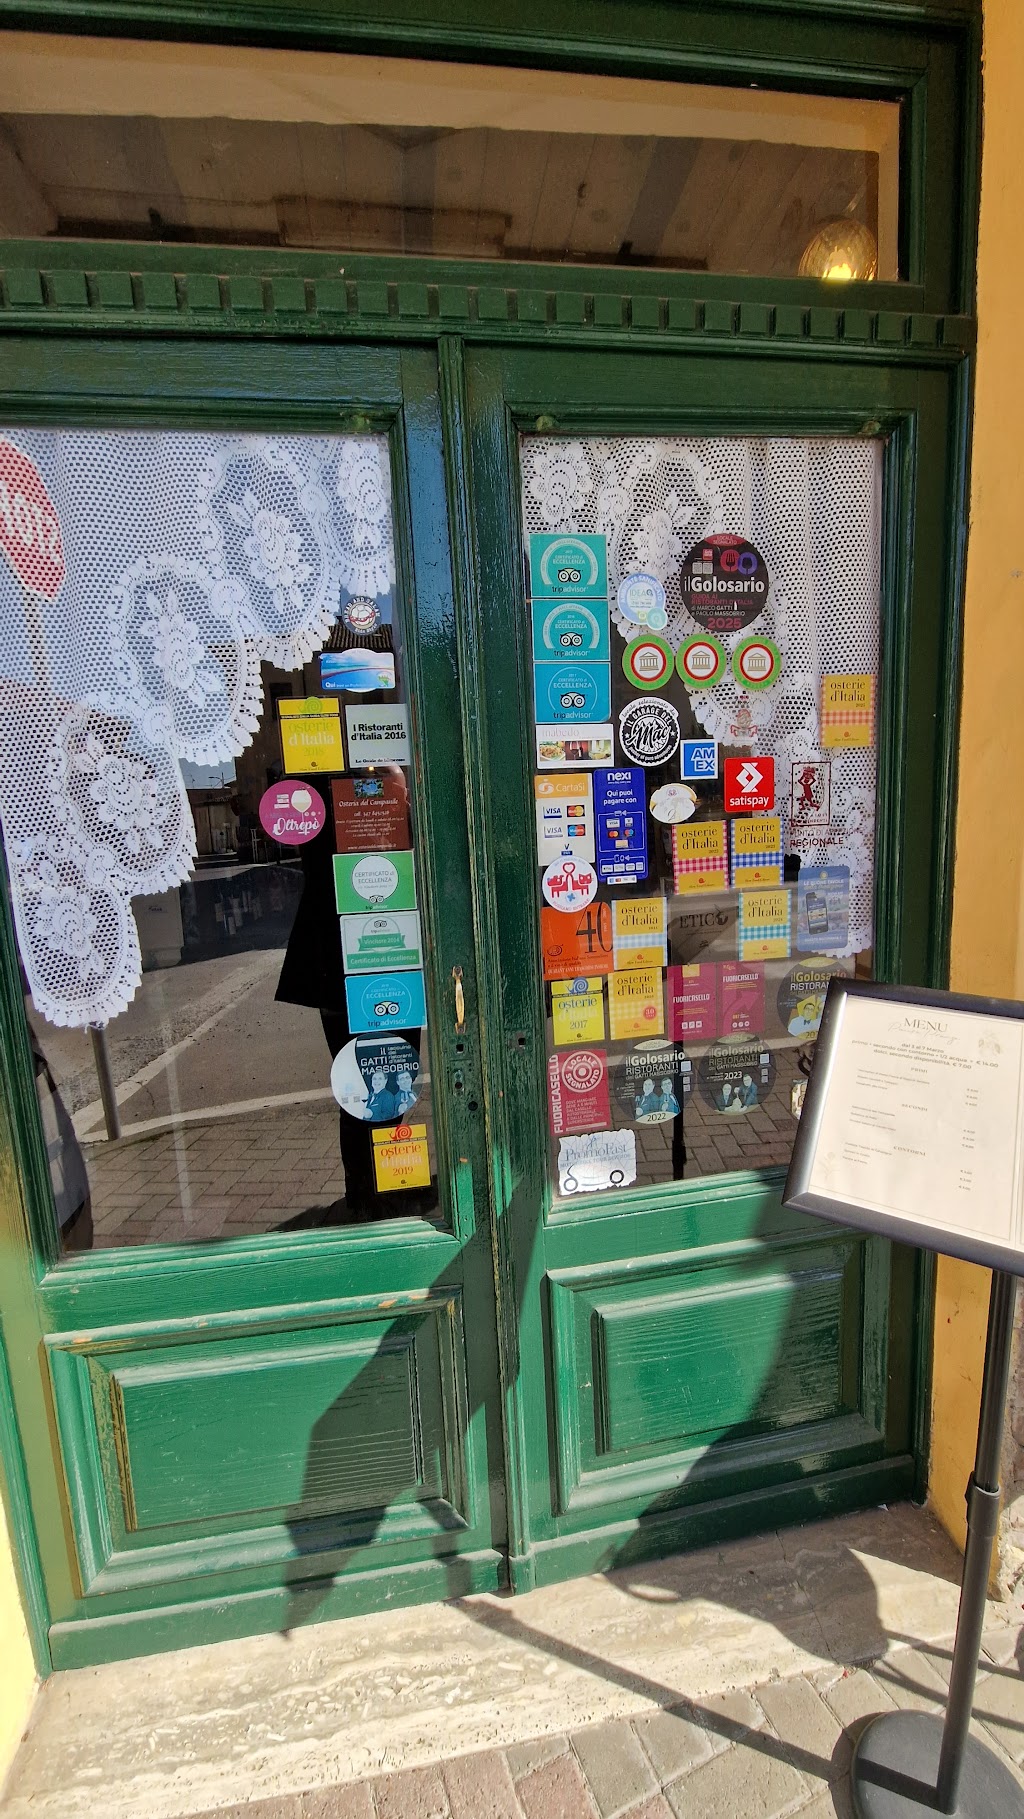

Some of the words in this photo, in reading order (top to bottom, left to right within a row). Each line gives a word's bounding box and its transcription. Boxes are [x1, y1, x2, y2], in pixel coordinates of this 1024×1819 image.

[552, 585, 587, 593] tripadvisor
[707, 617, 742, 629] 2025
[830, 678, 866, 690] osterie
[830, 690, 866, 702] d'Italia
[553, 711, 592, 720] tripadvisor
[632, 706, 660, 720] GARAGE
[288, 719, 333, 733] osterie
[358, 723, 403, 731] Ristoranti
[350, 732, 382, 740] d'Italia
[385, 732, 406, 740] 2016
[607, 771, 631, 781] nexi
[556, 782, 585, 792] CartaSi
[619, 789, 633, 797] puoi
[603, 798, 625, 806] pagare
[730, 796, 769, 808] satispay
[272, 817, 320, 835] Oltrepò
[547, 826, 562, 834] VISA
[681, 826, 717, 838] osterie
[739, 822, 775, 833] osterie
[682, 837, 718, 850] d'Italia
[740, 833, 775, 844] d'Italia
[790, 837, 843, 848] REGIONALE
[747, 895, 782, 907] osterie
[621, 903, 658, 915] osterie
[748, 906, 783, 918] d'Italia
[621, 914, 658, 927] d'Italia
[576, 902, 613, 952] 40
[616, 972, 652, 985] osterie
[722, 973, 759, 983] FUORICASELLO
[366, 991, 406, 999] ECCELLENZA
[617, 983, 654, 996] d'Italia
[558, 996, 597, 1009] osterie
[672, 993, 710, 1003] FUORICASELLO
[367, 1018, 407, 1028] tripadvisor
[569, 1020, 588, 1029] 2017
[904, 1017, 948, 1033] MENU
[908, 1049, 934, 1057] contorno
[360, 1056, 388, 1067] GATTI
[567, 1055, 597, 1070] LOCALE
[709, 1054, 758, 1066] RISTORANTI
[361, 1061, 420, 1075] MASSOBRIO
[626, 1062, 678, 1075] RISTORANTI
[565, 1069, 600, 1089] SEGNALATO
[724, 1071, 743, 1080] 2023
[549, 1054, 563, 1133] FUORICASELLO
[647, 1113, 667, 1122] 2022
[380, 1142, 421, 1157] osterie
[565, 1143, 626, 1161] PromoFast
[392, 1166, 413, 1176] 2019
